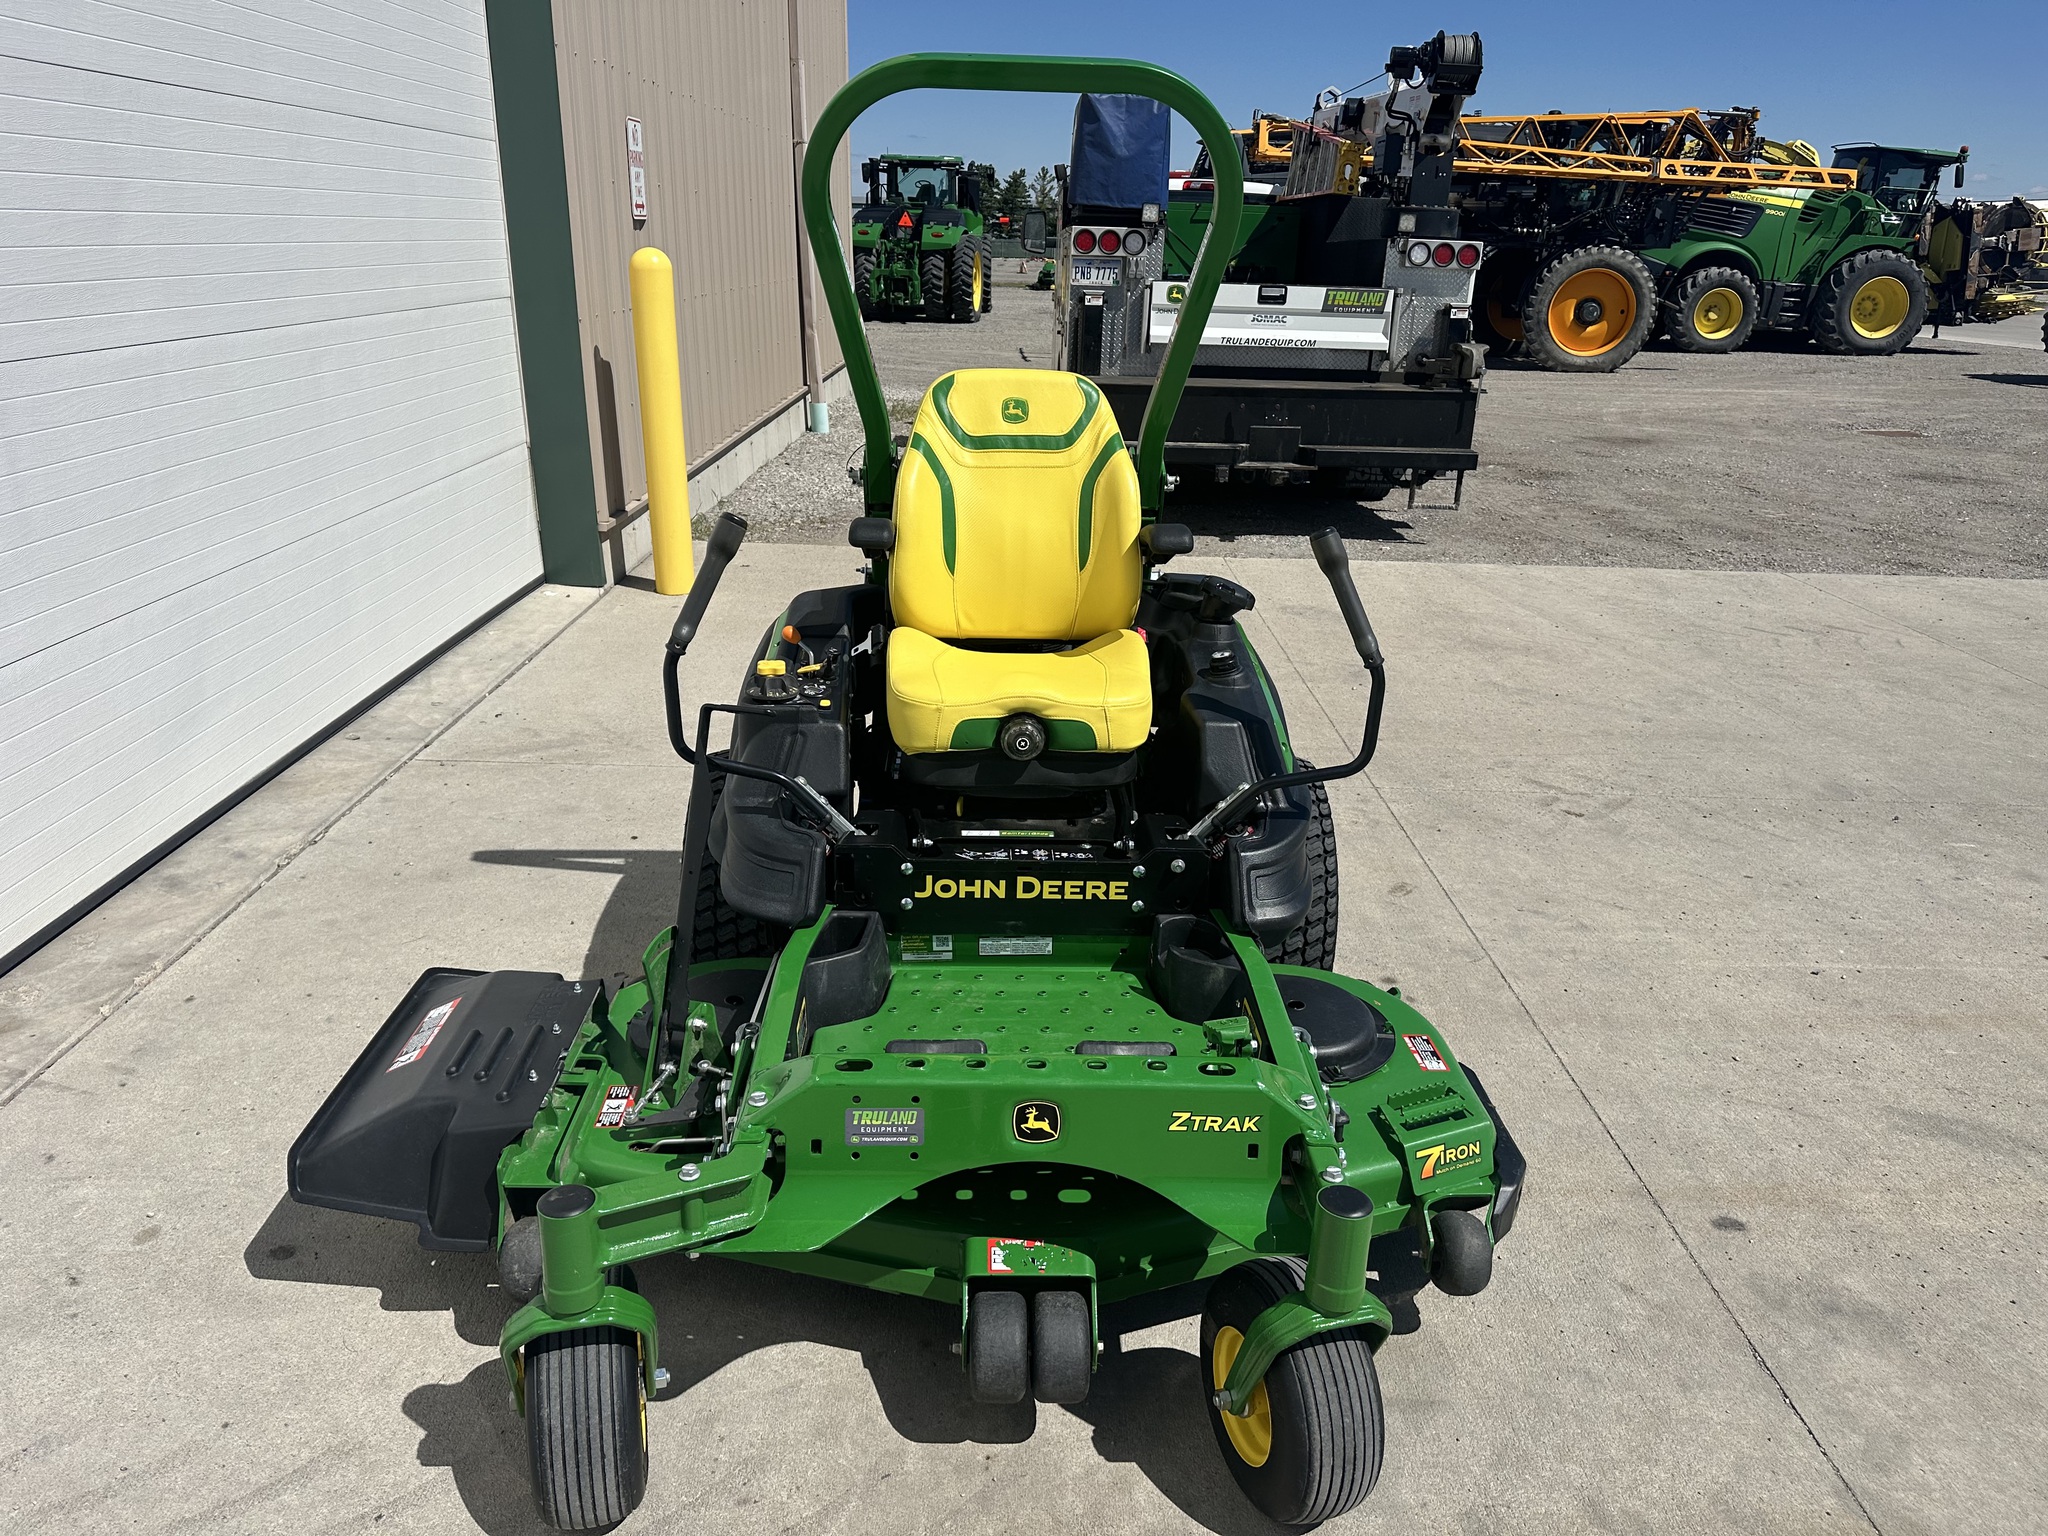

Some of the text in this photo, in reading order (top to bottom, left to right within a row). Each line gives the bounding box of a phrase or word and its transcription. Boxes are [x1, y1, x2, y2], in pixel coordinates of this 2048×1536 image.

[1074, 266, 1119, 281] PNB 7775
[1327, 290, 1385, 307] TRULAND
[1250, 314, 1288, 325] JOMAC
[1220, 337, 1317, 348] TRULANDEQUIP.COM
[914, 875, 1129, 900] JOHN DEERE
[852, 1110, 918, 1125] TRULAND
[1168, 1111, 1262, 1132] ZTRAK
